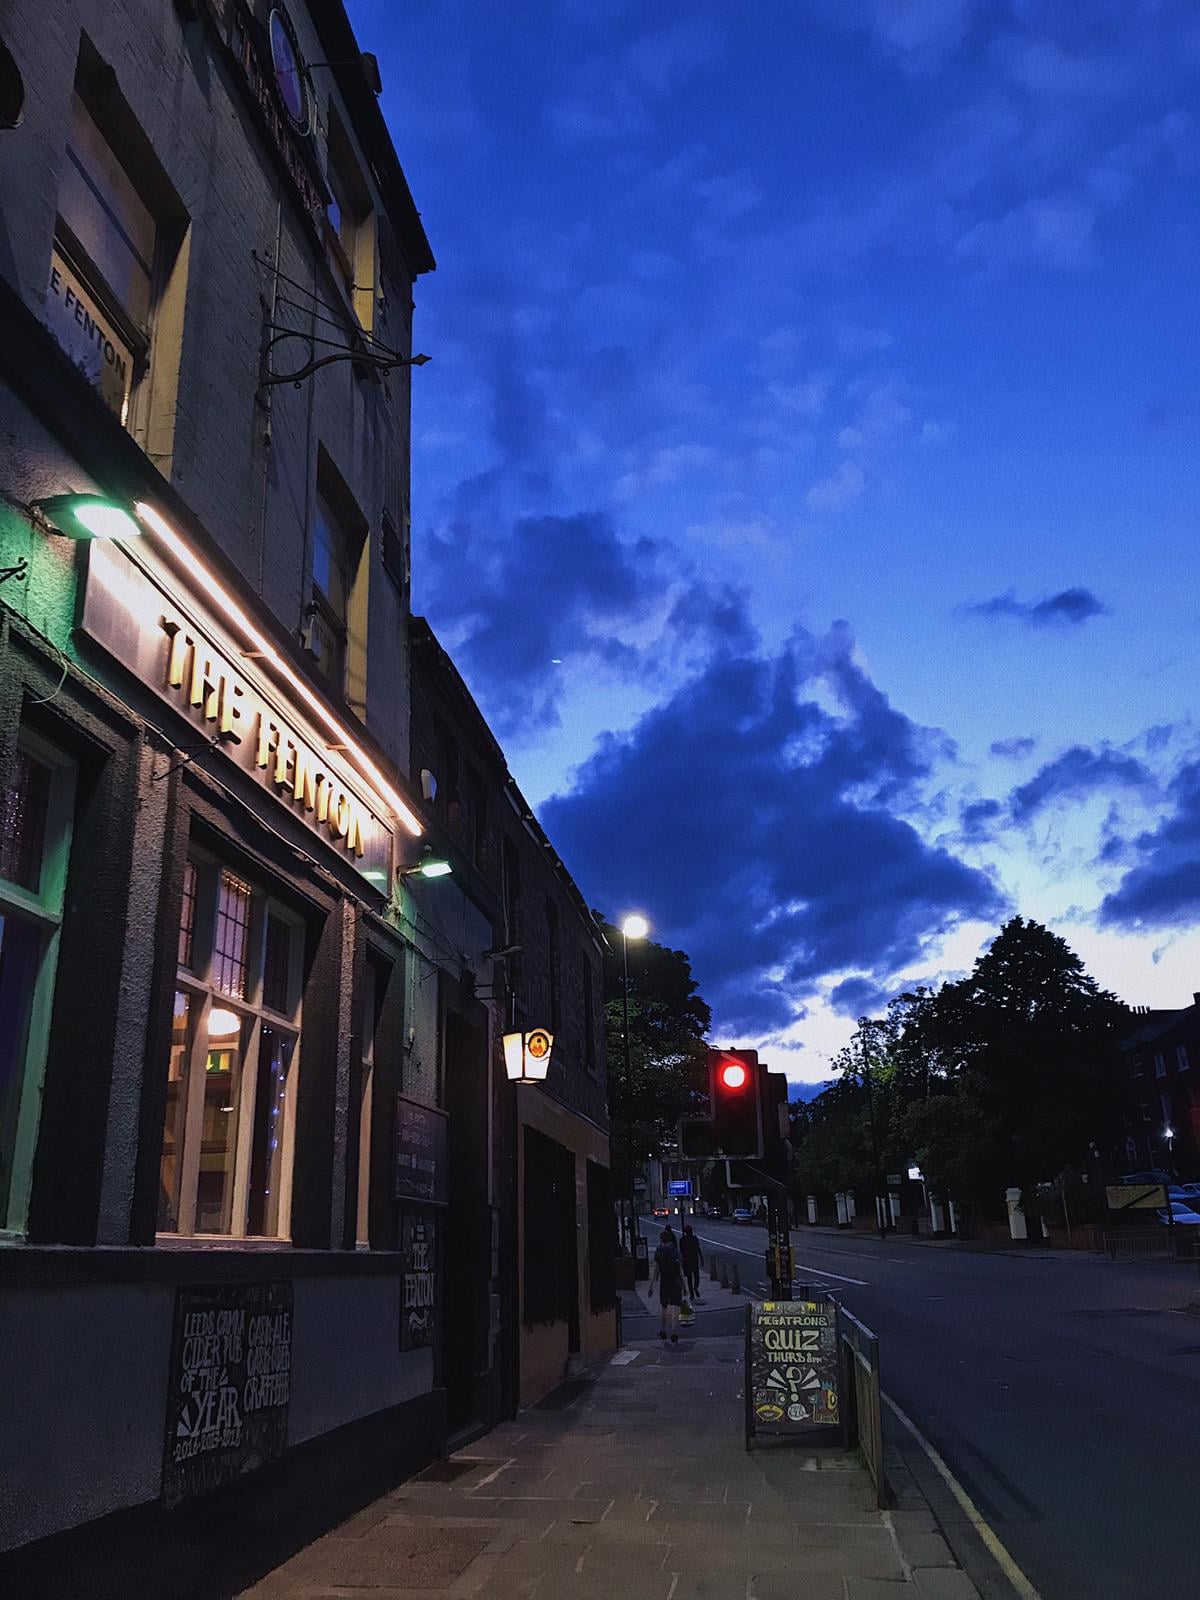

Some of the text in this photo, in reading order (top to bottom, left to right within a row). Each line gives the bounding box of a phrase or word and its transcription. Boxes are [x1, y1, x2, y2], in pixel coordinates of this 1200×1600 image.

[64, 286, 126, 382] FENTON
[158, 614, 366, 859] THE FENTON
[404, 1272, 434, 1308] FENTON
[185, 1311, 215, 1338] LEEDS
[758, 1316, 827, 1326] MEGATRONS
[183, 1335, 243, 1370] CIDER PUB
[766, 1351, 805, 1363] THURS
[181, 1367, 221, 1393] OF THE
[191, 1386, 243, 1438] YEAR
